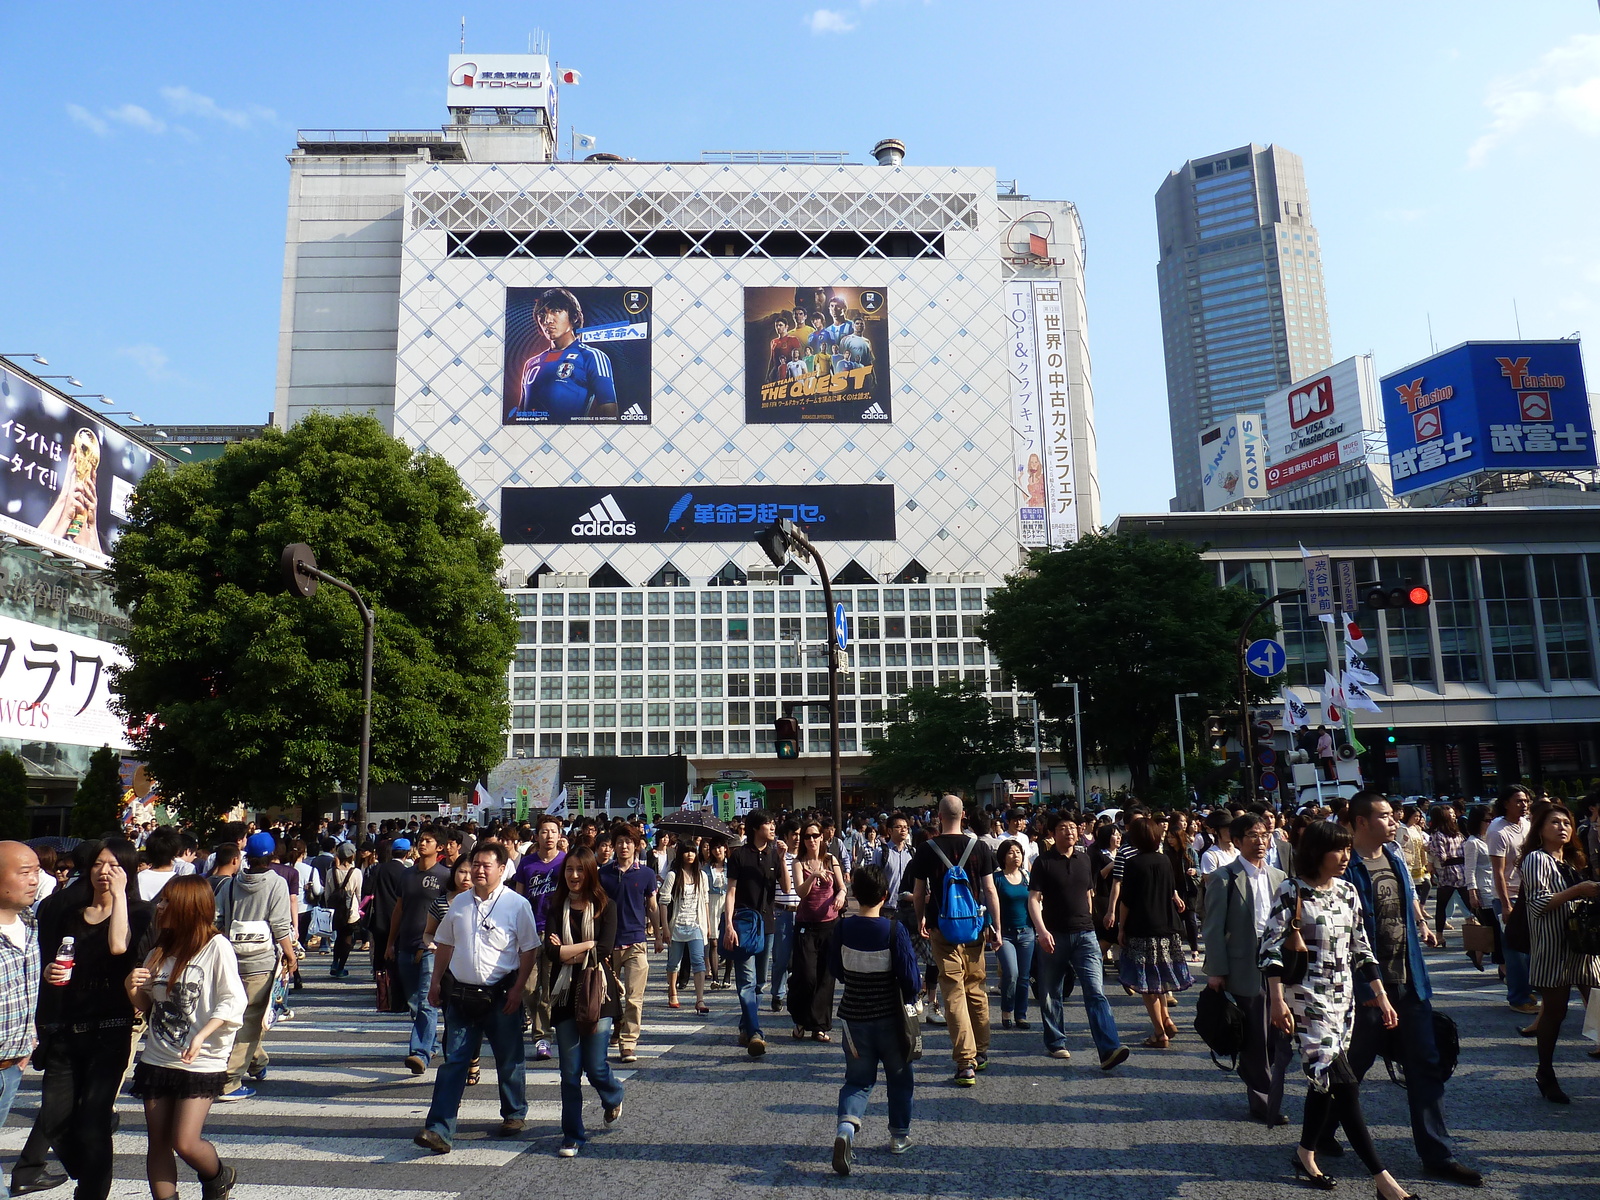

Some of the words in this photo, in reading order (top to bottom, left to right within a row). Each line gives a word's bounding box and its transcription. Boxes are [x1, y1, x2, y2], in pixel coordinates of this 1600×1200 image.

[482, 72, 541, 80] 東急東横店
[583, 328, 646, 341] いざ革命へ。
[761, 384, 788, 401] THE
[790, 365, 873, 397] QUEST
[1430, 385, 1453, 405] shop
[1540, 374, 1565, 389] shop
[1044, 315, 1072, 514] 世界の中古カメラフェア
[1284, 443, 1298, 454] DC
[1299, 423, 1344, 448] MasterCard
[1290, 430, 1303, 441] DC
[1305, 421, 1323, 436] VISA
[1489, 424, 1587, 452] 武富士
[1204, 426, 1237, 486] SANKYO
[1242, 420, 1259, 490] SANKYO
[1342, 440, 1358, 451] MUFG
[1343, 447, 1360, 456] PLAZA
[1391, 432, 1473, 480] 武富士
[1282, 451, 1336, 478] 三菱東京UFJ銀行
[694, 504, 826, 524] 革命ヲ起コセ。
[1468, 496, 1479, 505] 9F
[571, 520, 636, 536] adidas
[1315, 560, 1331, 610] 渋谷駅前
[1342, 563, 1354, 609] スクランブル交差点
[0, 637, 114, 717] フラワ
[0, 698, 50, 729] wers
[529, 869, 553, 887] Rock
